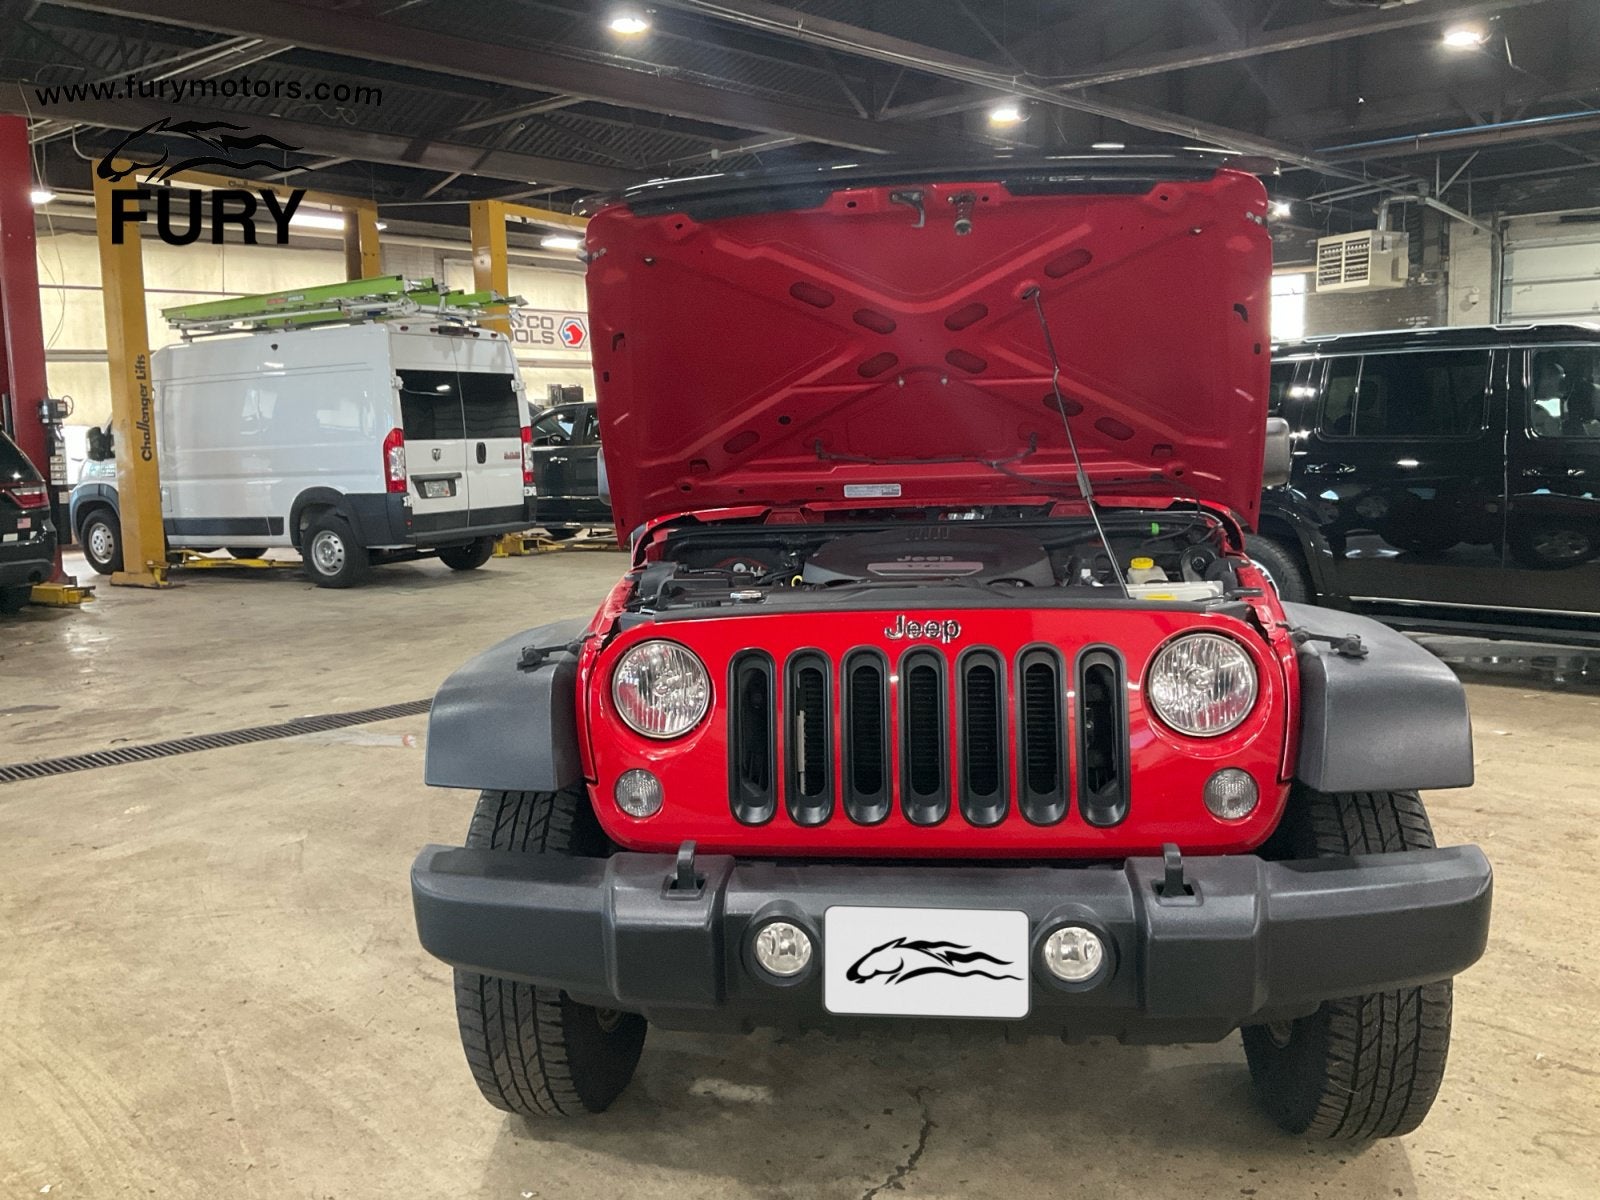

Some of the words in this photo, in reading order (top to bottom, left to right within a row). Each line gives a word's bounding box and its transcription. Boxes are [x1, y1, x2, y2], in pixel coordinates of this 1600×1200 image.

[510, 328, 554, 345] OLS
[135, 353, 147, 381] Lifts
[136, 383, 153, 462] Challenger
[884, 614, 962, 645] Jeep
